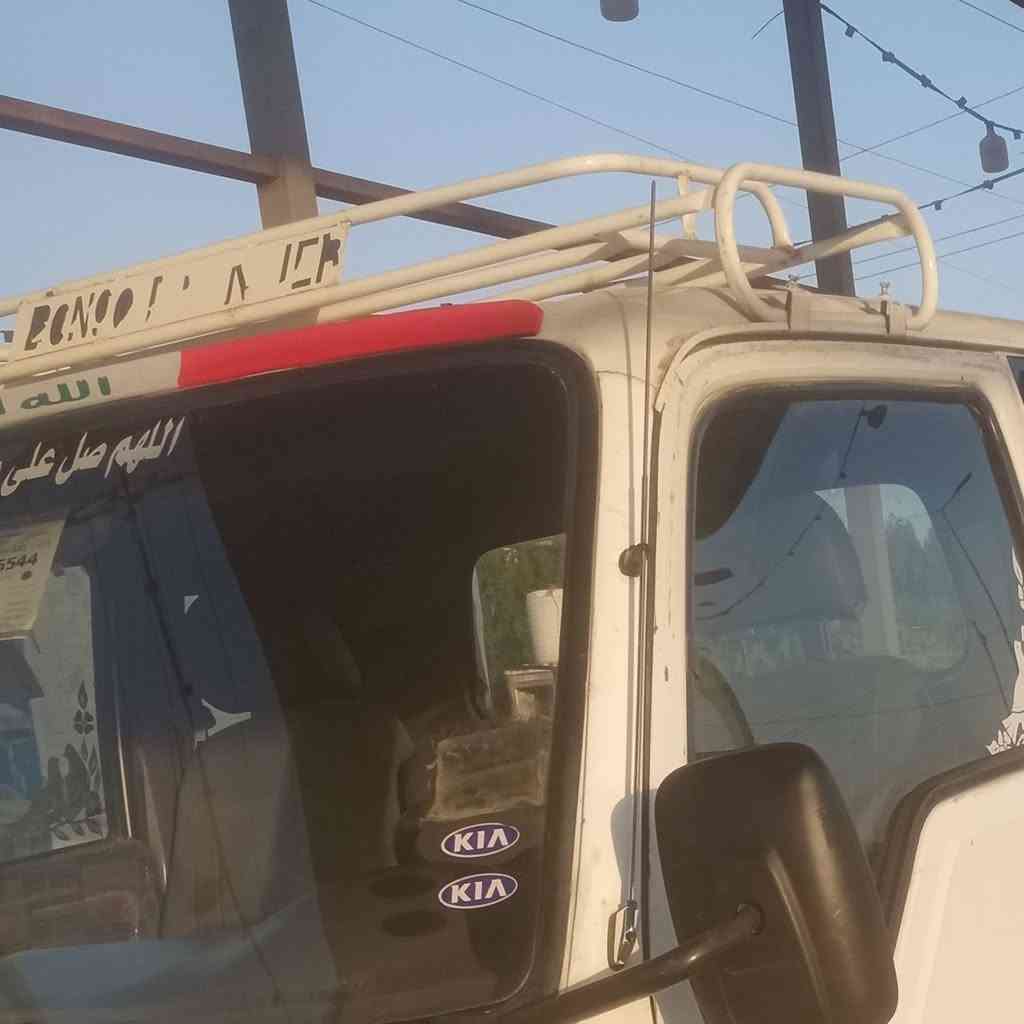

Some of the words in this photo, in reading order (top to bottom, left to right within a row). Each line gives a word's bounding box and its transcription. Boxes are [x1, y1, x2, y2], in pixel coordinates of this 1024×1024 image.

[20, 375, 112, 410] الله
[103, 416, 186, 479] اللهم
[453, 827, 509, 853] KIA
[450, 878, 507, 904] KIA
